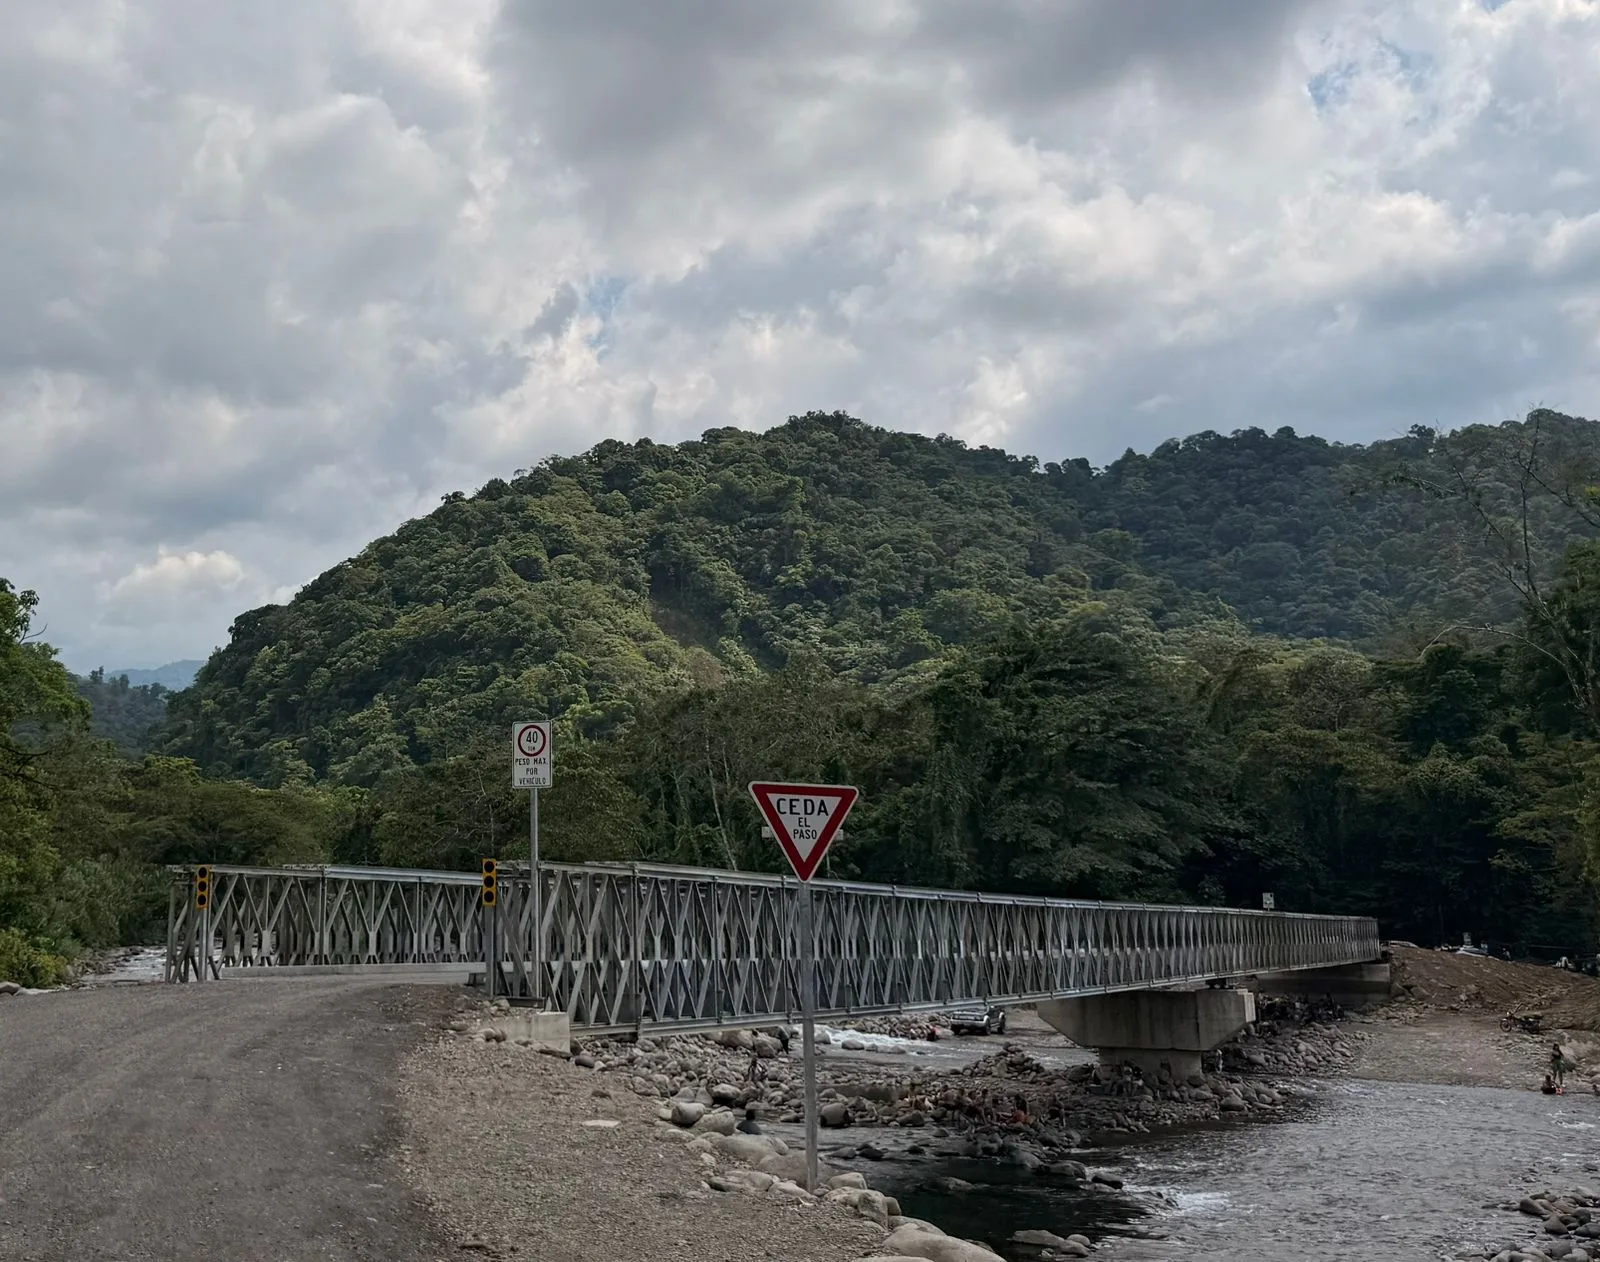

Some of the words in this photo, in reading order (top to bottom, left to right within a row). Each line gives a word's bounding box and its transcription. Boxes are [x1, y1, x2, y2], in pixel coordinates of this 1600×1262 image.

[526, 731, 538, 743] 40
[515, 758, 530, 766] PESO
[526, 767, 538, 775] POR
[776, 798, 829, 816] CEDA
[798, 817, 811, 828] EL
[793, 829, 818, 840] PASO
